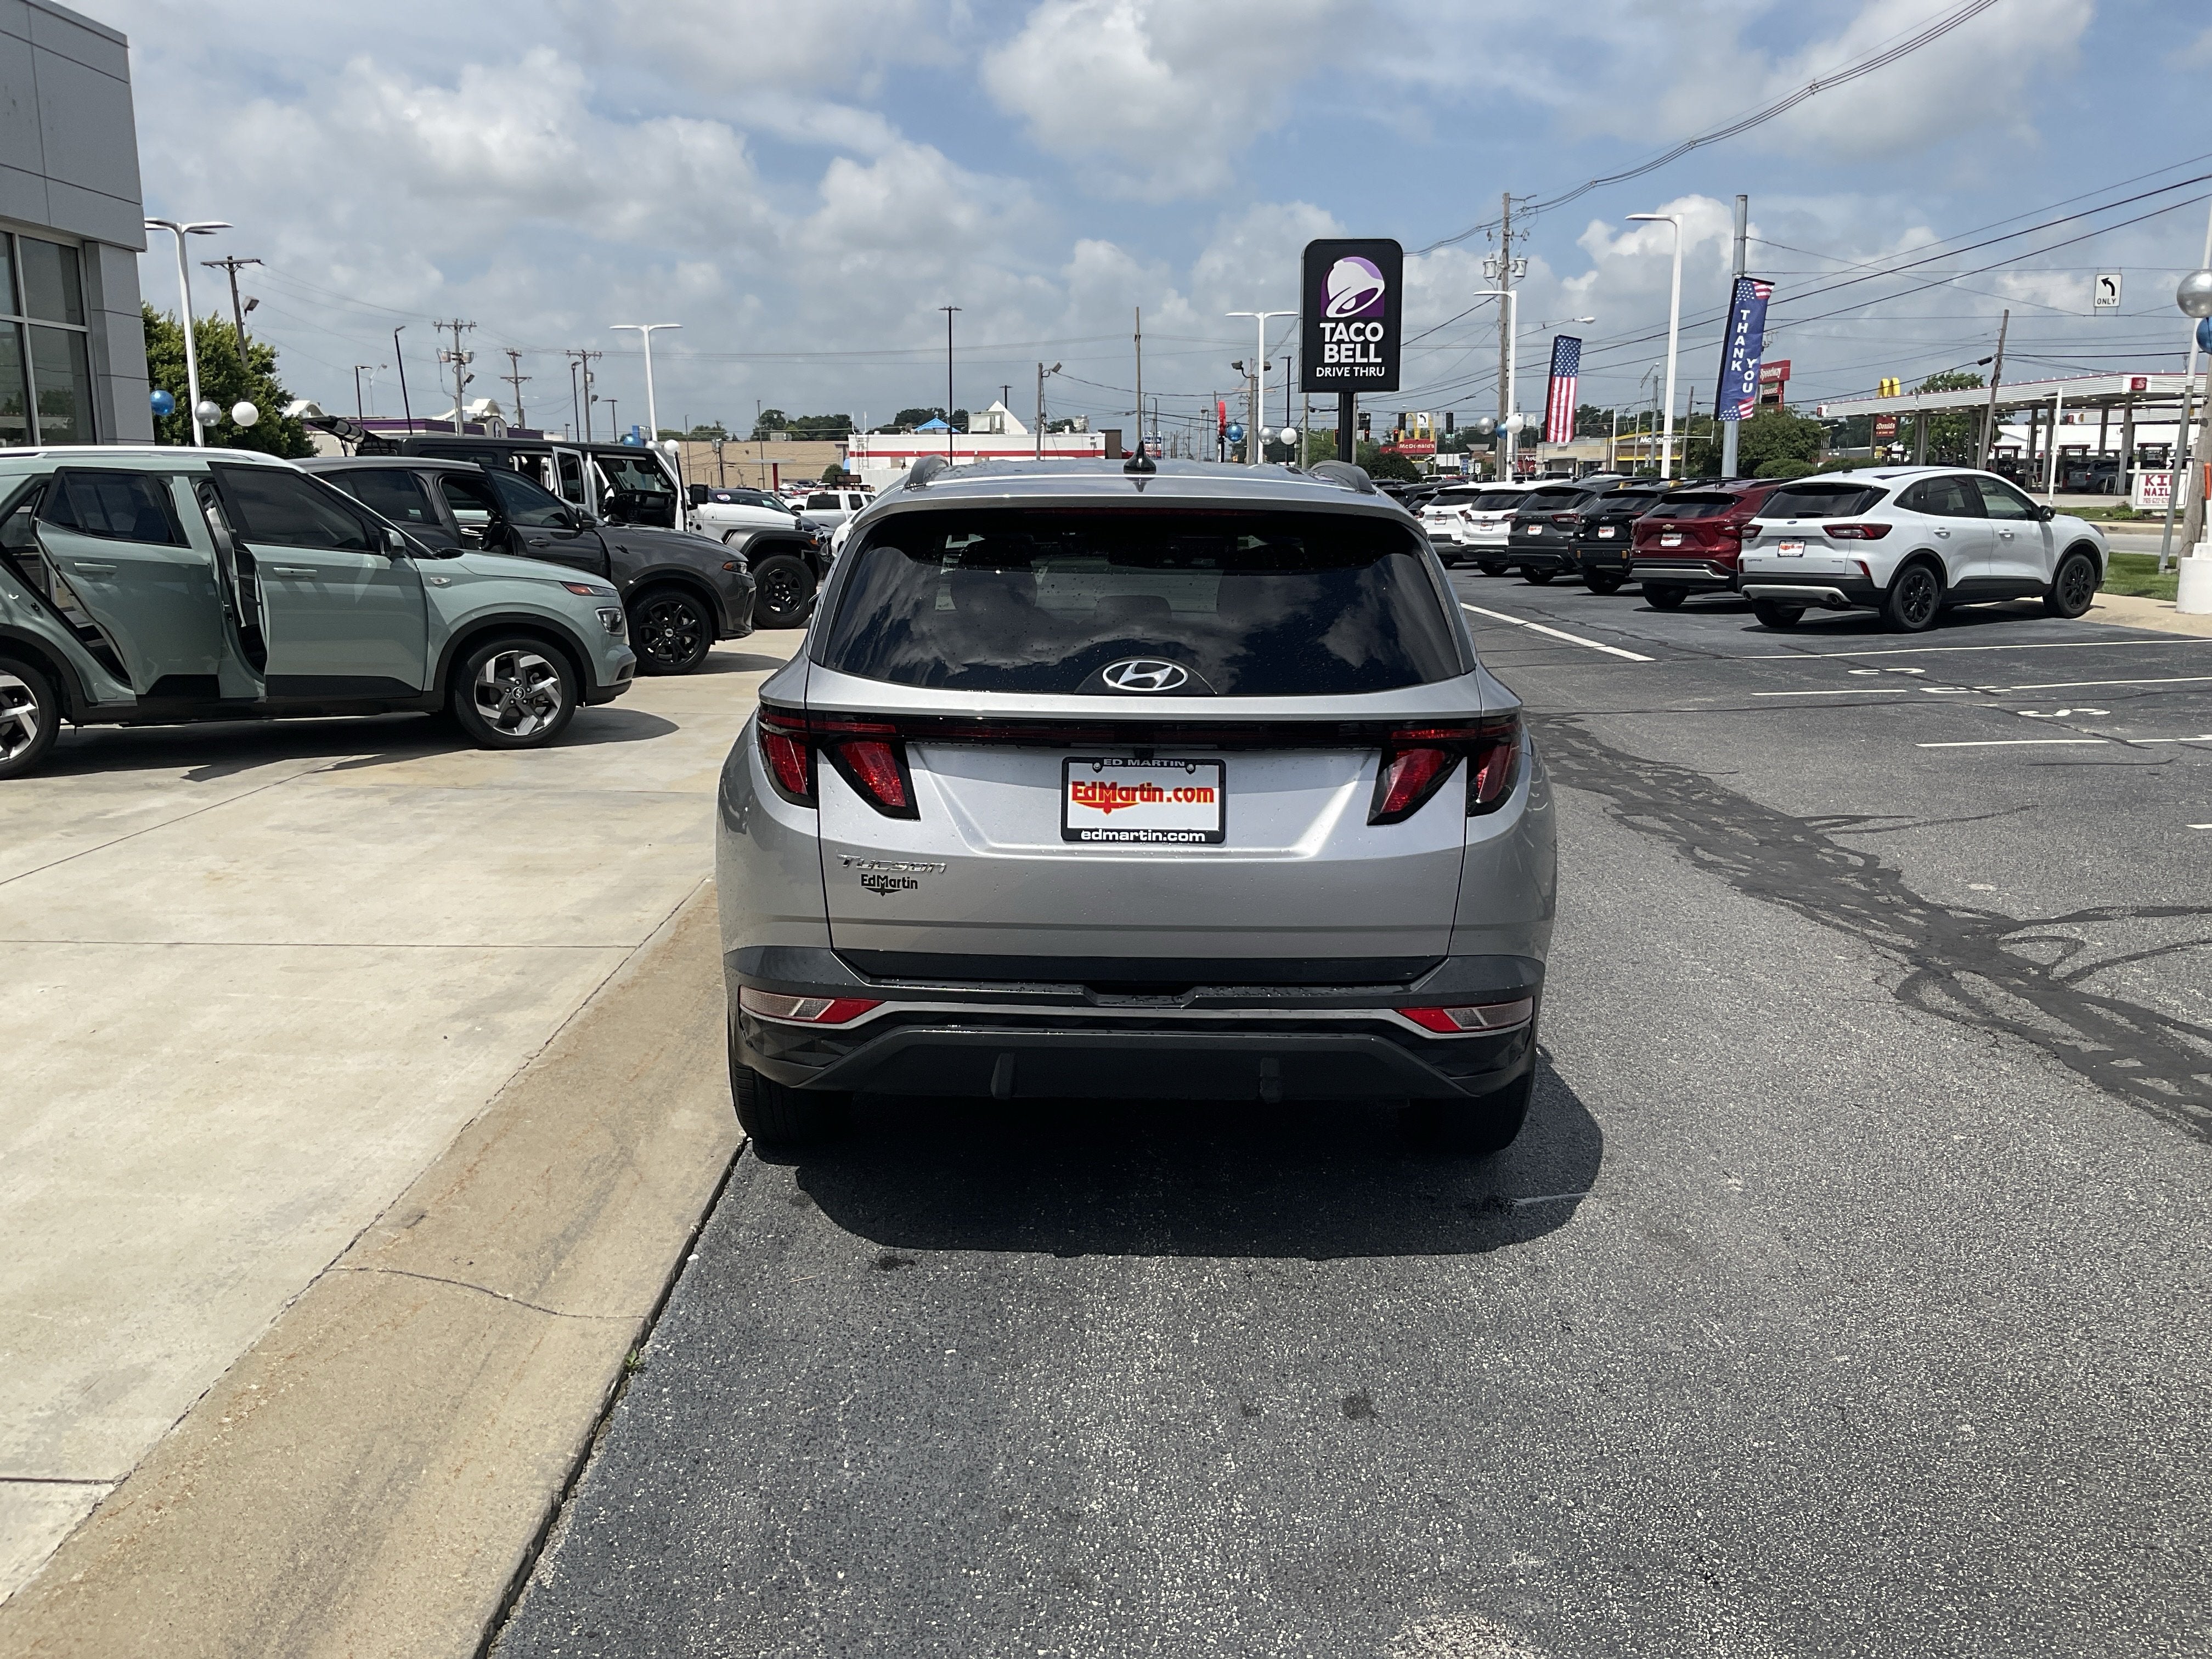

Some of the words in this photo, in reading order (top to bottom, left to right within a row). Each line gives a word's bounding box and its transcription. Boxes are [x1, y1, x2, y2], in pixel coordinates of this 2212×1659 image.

[1319, 322, 1384, 342] TACO
[1324, 344, 1382, 363] BELL
[1731, 309, 1750, 371] THANK
[1742, 358, 1757, 393] YOU
[1316, 367, 1350, 377] DRIVE
[1353, 367, 1385, 376] THRU
[2144, 488, 2170, 496] NAIL
[1071, 780, 1215, 804] EdMartin.com
[1081, 828, 1206, 842] edmartin.com
[861, 873, 918, 890] EdMartin
